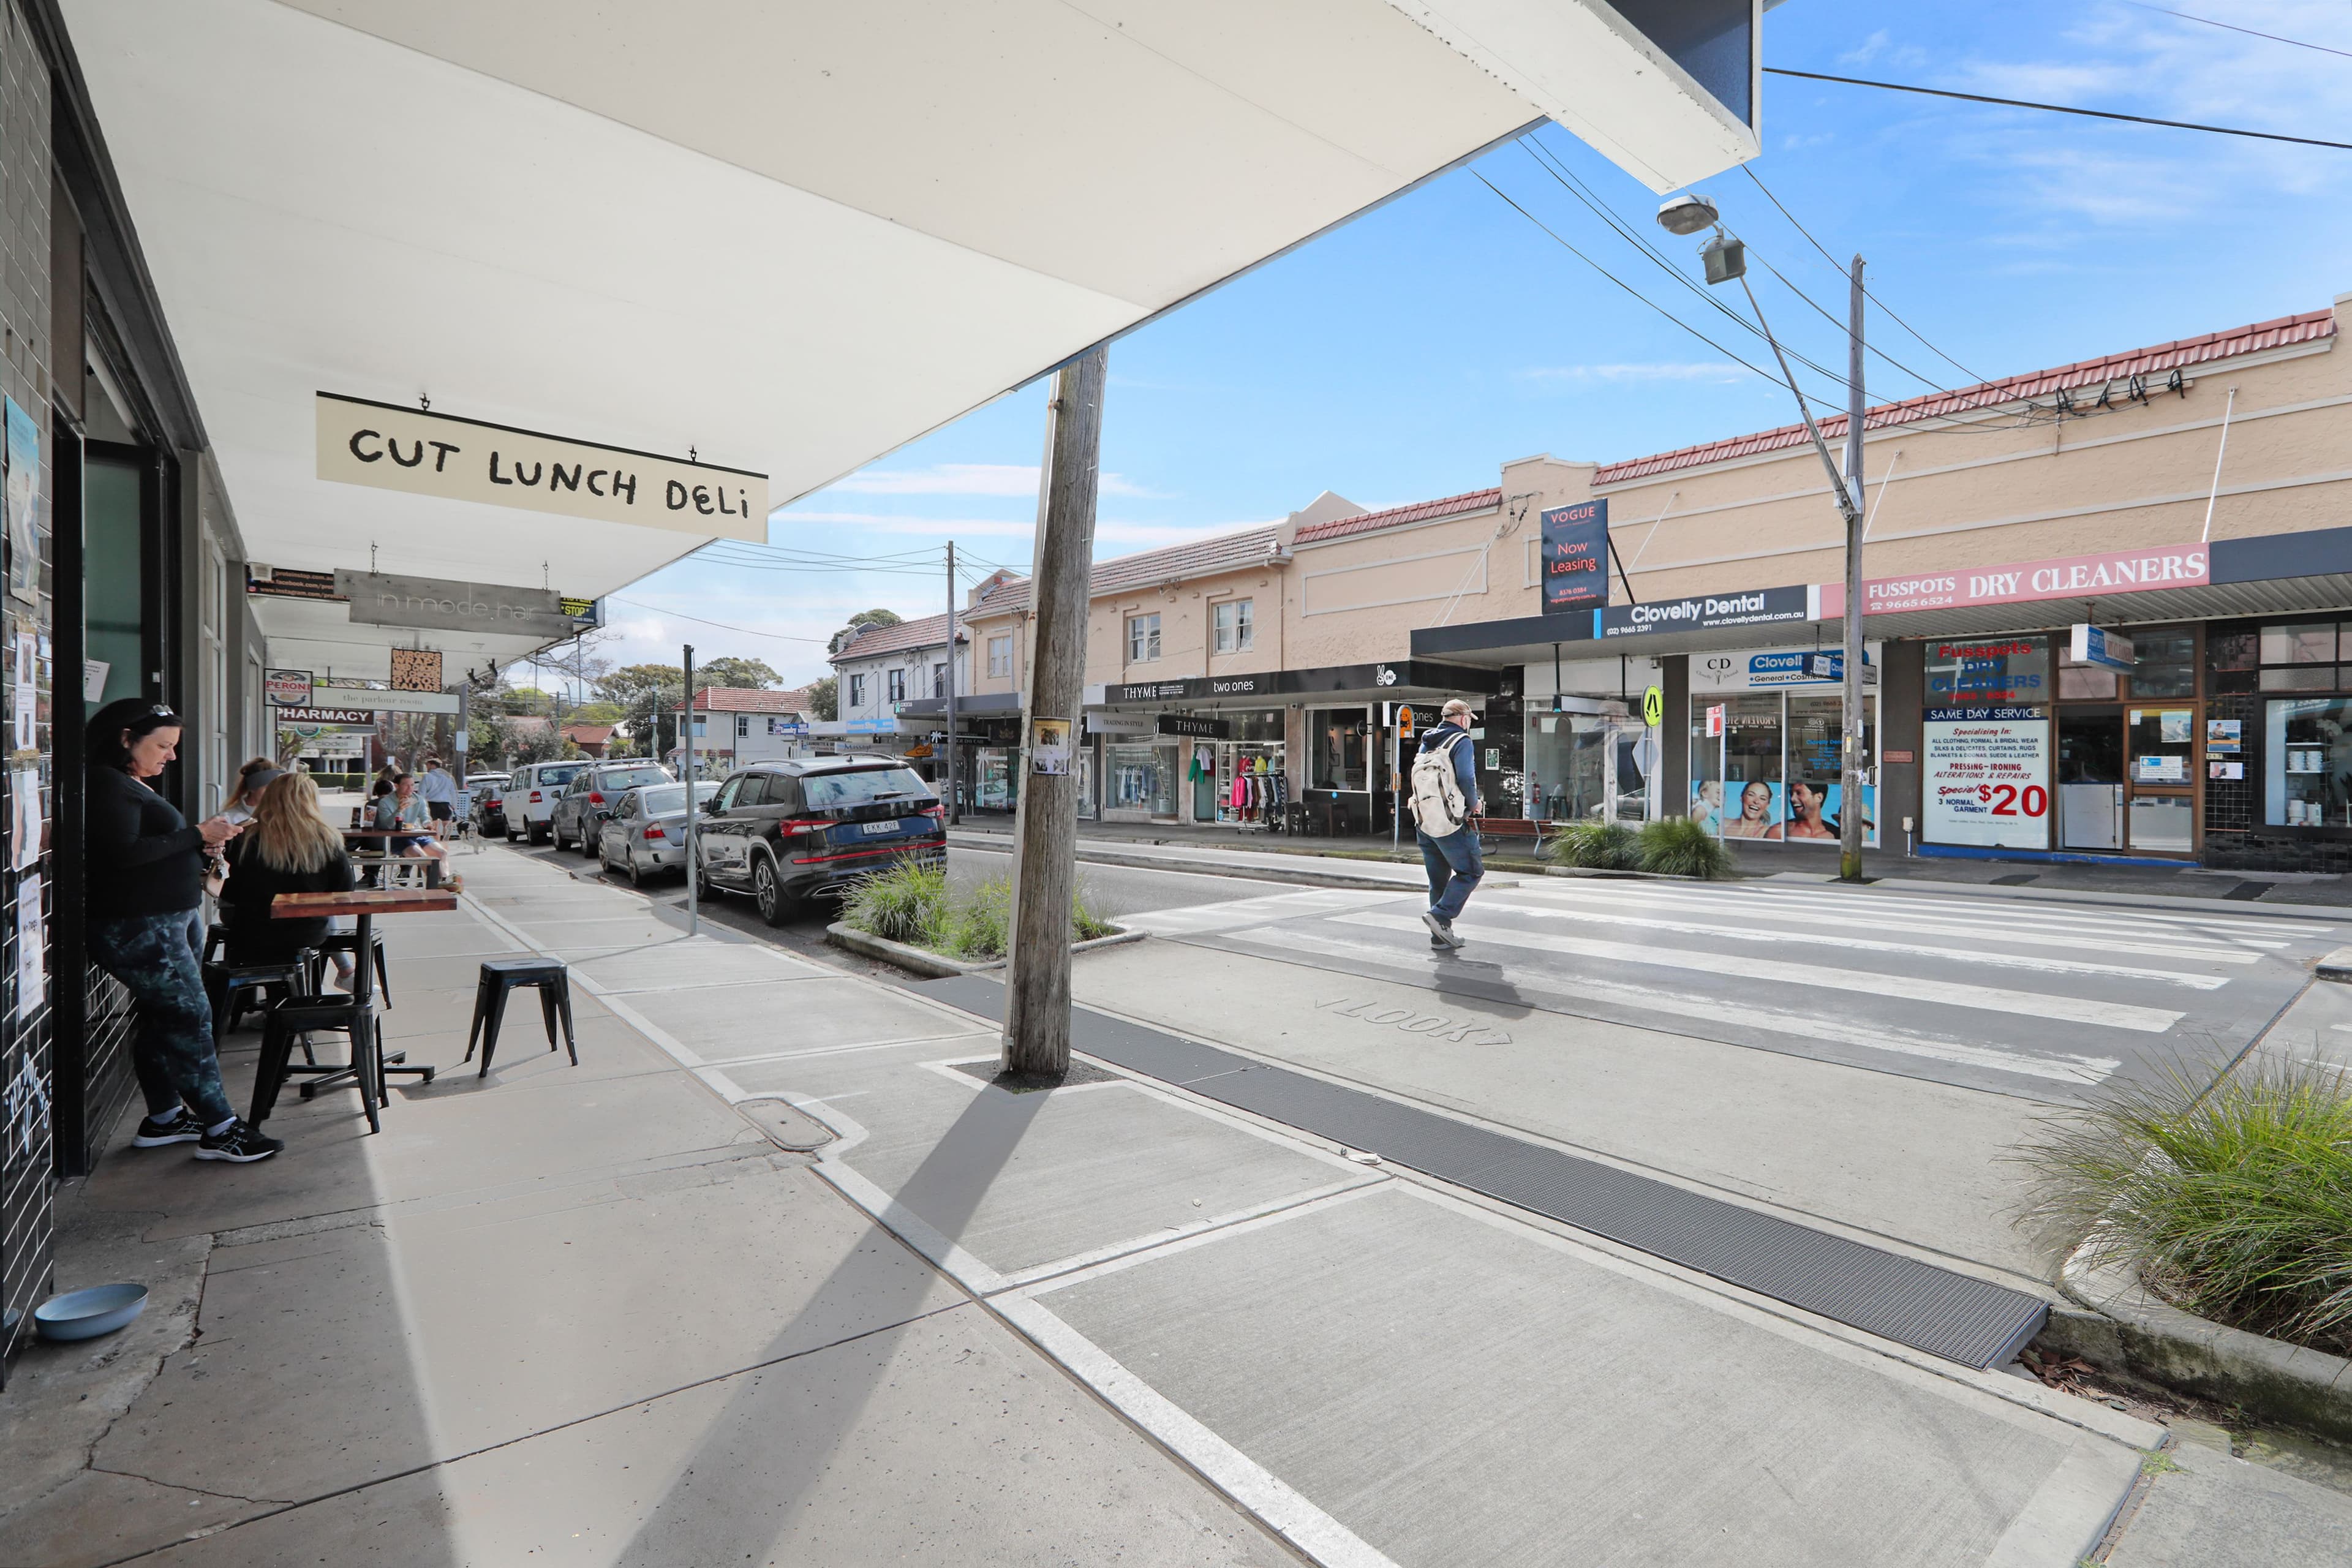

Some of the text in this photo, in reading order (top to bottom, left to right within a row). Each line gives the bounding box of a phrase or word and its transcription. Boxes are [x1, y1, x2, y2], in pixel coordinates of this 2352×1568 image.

[349, 429, 460, 471] CUT
[489, 451, 636, 504] LUNCH
[1551, 507, 1596, 524] VOGUE
[1558, 542, 1588, 556] Now
[1551, 558, 1597, 573] Leasing
[1969, 552, 2206, 598] DRY CLEANERS
[1869, 576, 1956, 598] FUSSPOTS
[407, 582, 488, 617] mode
[1886, 596, 1953, 609] 9665 6524
[565, 605, 586, 617] STOP
[1631, 594, 1765, 624] Clovelly Dental
[1703, 611, 1804, 627] www.clovellydental.com.au
[1939, 641, 2032, 659] Fusspots
[1755, 656, 1803, 669] Clovell
[1964, 659, 2005, 673] DRY
[266, 680, 311, 690] PERONI
[1214, 680, 1254, 692] two ones
[1931, 674, 2041, 691] CLEANERS
[1123, 686, 1157, 699] THYME
[1414, 712, 1433, 722] ones
[1931, 708, 2041, 719] SAME DAY SERVICE
[1176, 720, 1213, 734] THYME
[1953, 728, 1998, 736] Specialising
[1937, 783, 2048, 818] Special $20
